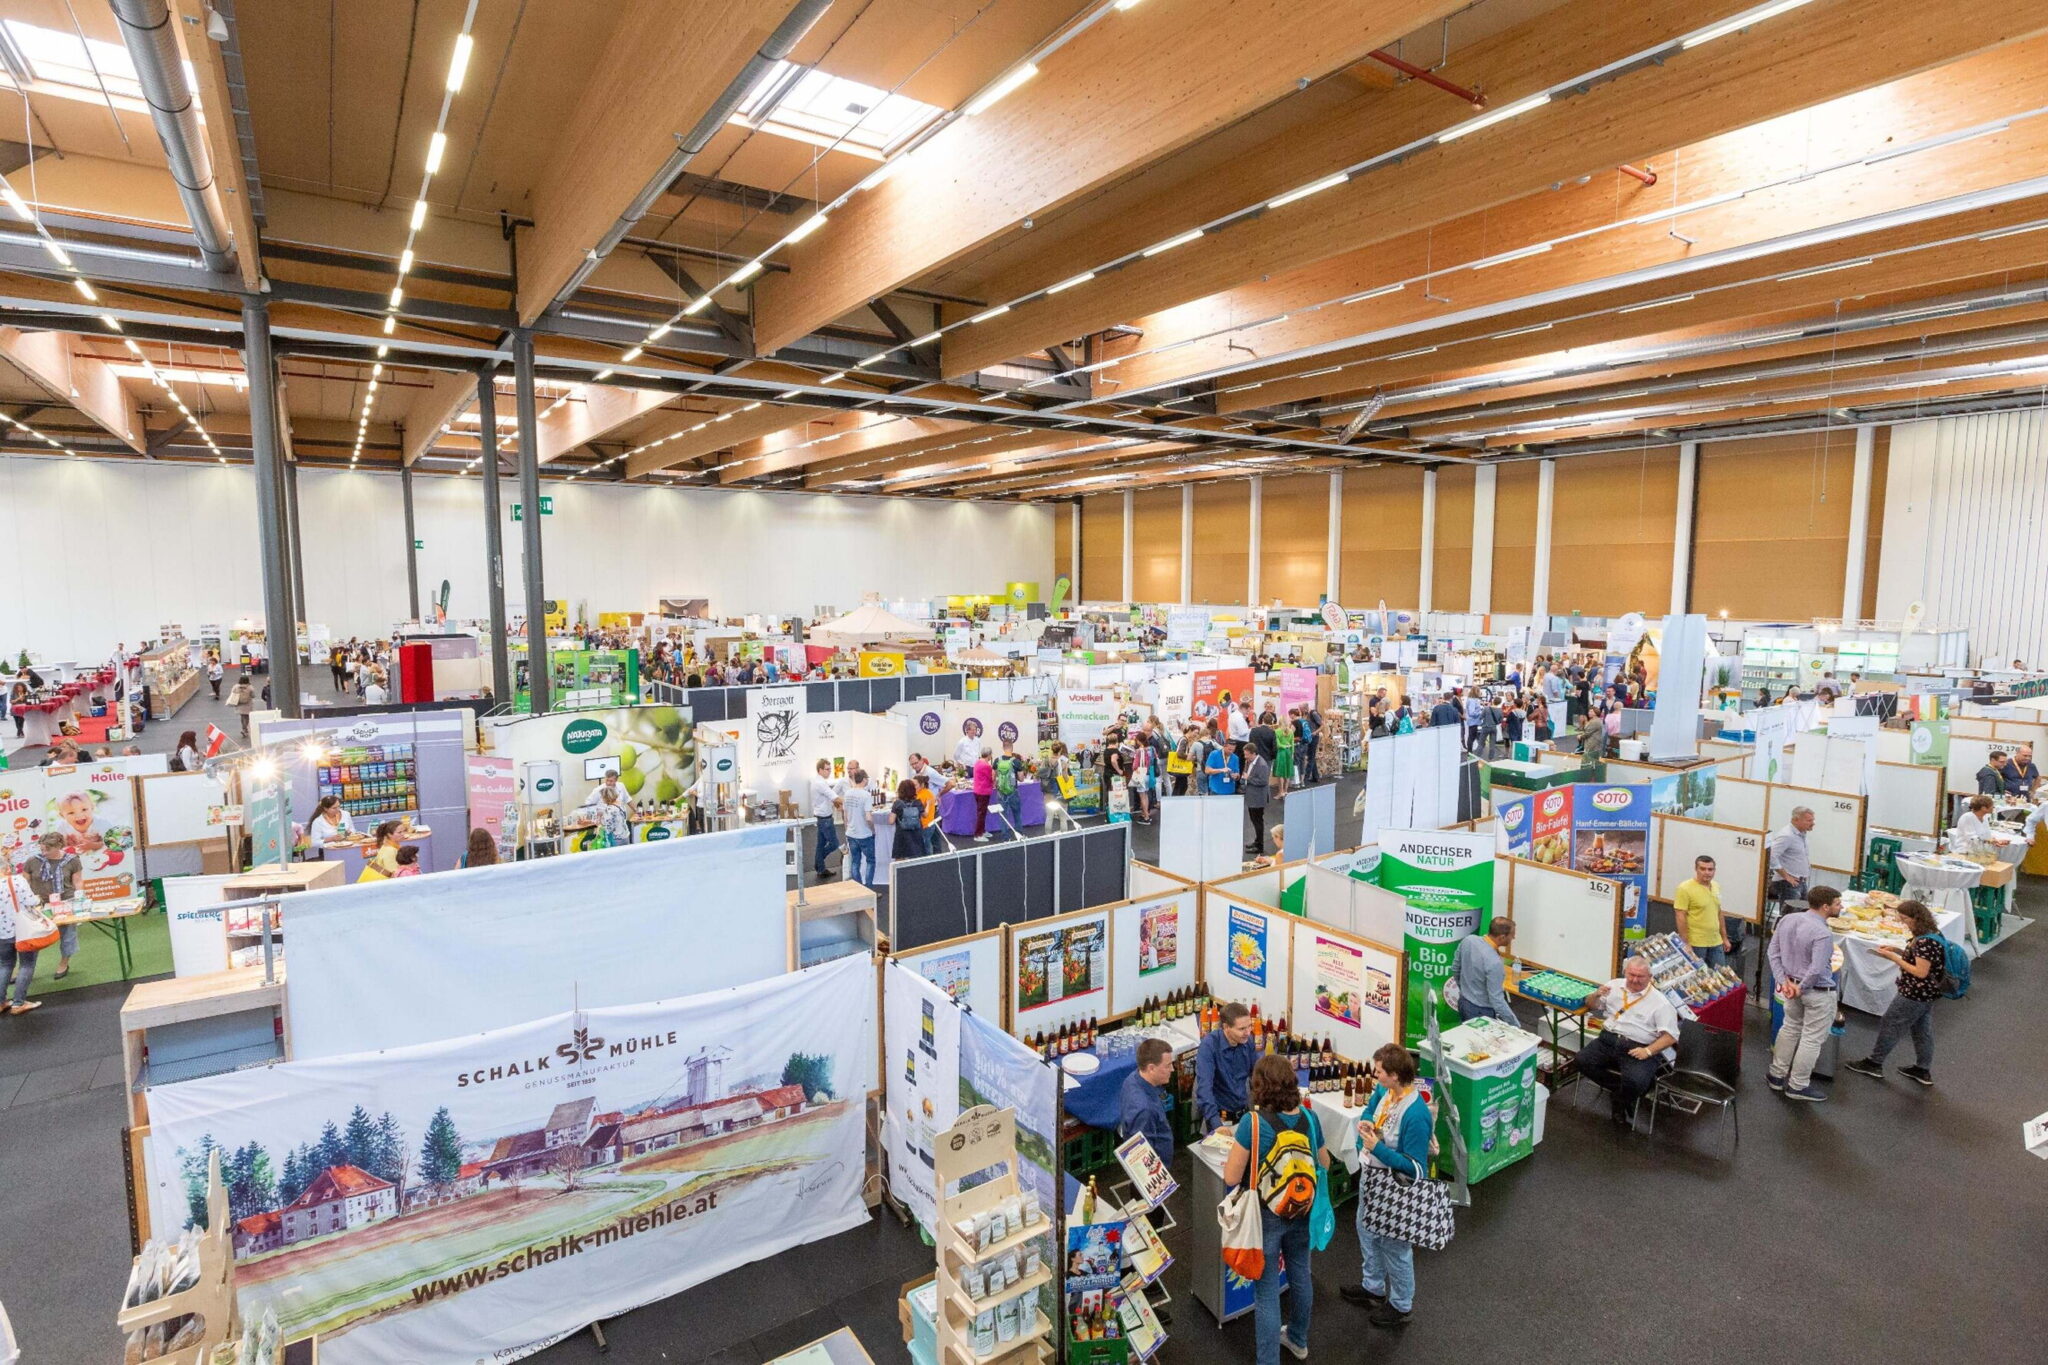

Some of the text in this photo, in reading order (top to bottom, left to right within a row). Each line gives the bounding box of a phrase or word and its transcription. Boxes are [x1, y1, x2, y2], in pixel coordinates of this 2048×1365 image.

[91, 773, 125, 783] Holle
[1545, 797, 1561, 810] SOTO
[1597, 792, 1628, 804] SOTO
[0, 799, 30, 813] olle
[1834, 801, 1852, 810] 166
[1535, 815, 1569, 834] Bio-Falafel
[1576, 820, 1647, 828] Hanf-Emmer-Bällchen
[1736, 837, 1755, 848] 164
[1400, 843, 1472, 858] ANDECHSER
[1417, 855, 1454, 866] NATUR
[1589, 880, 1610, 894] 162
[1405, 912, 1473, 927] NDECHSER
[1415, 925, 1453, 938] NATUR
[1419, 947, 1447, 964] Bio
[457, 1031, 678, 1088] SCHALK MÜHLE
[525, 1059, 635, 1089] GENUSSMANUFAKTUR
[567, 1080, 581, 1088] SEIT
[412, 1190, 718, 1305] www.schalk-muehle.at
